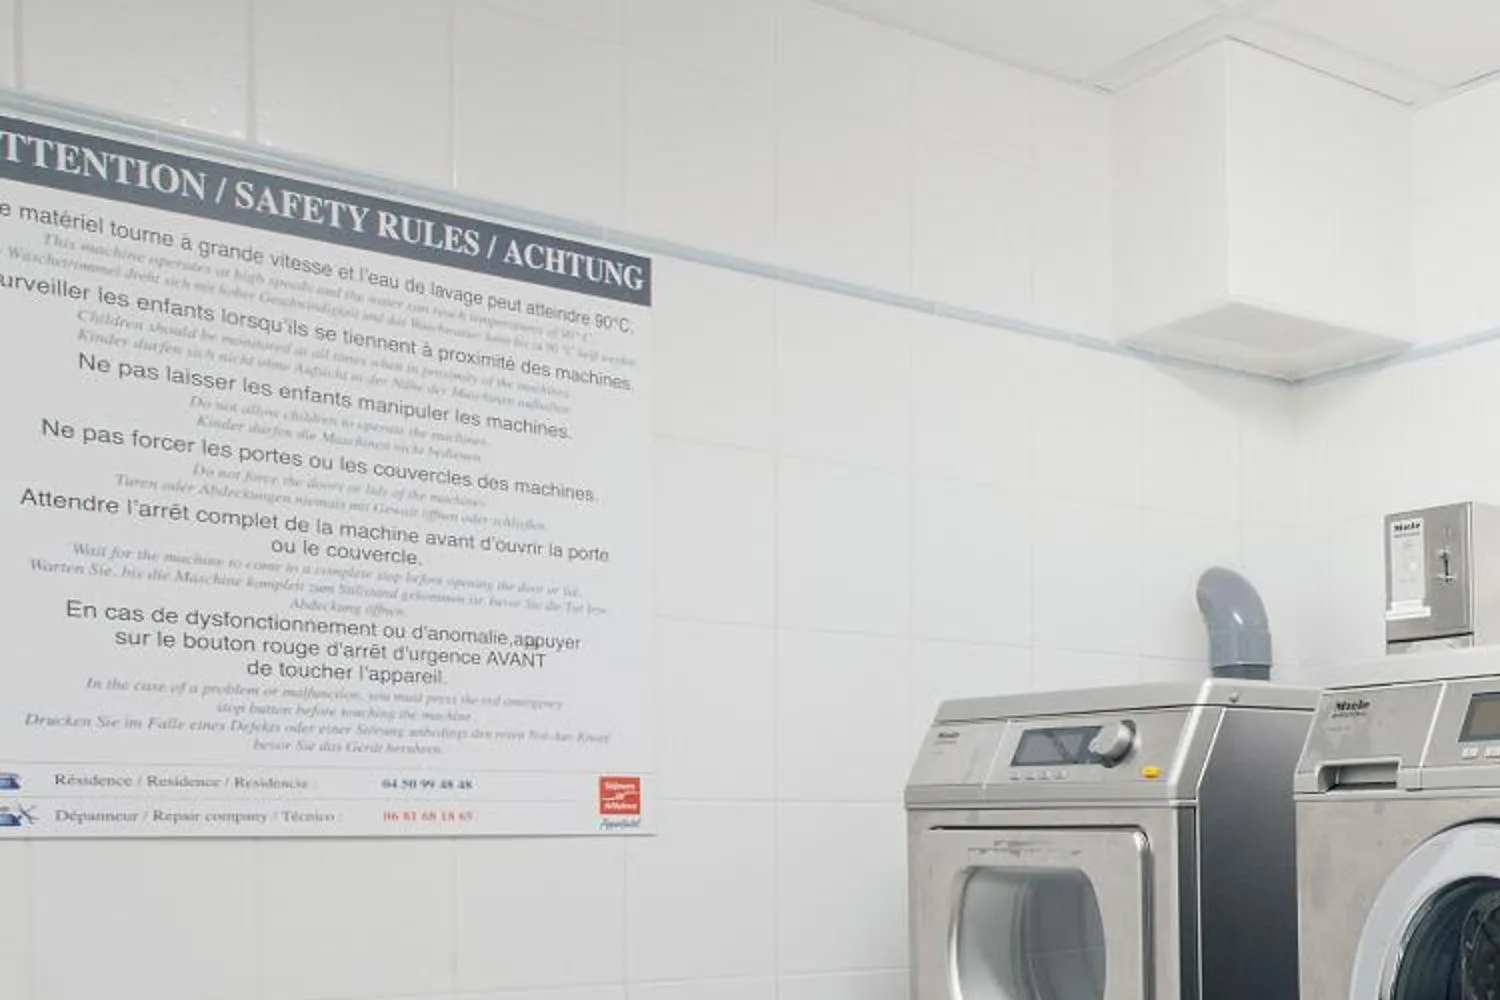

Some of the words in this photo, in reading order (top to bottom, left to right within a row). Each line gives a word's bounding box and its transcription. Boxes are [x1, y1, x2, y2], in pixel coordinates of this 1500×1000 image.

[0, 131, 206, 201] TTENTION
[234, 181, 369, 235] SAFETY
[377, 212, 479, 258] RULES
[503, 239, 646, 293] ACHTUNG
[0, 202, 11, 218] e
[19, 206, 103, 235] matériel
[110, 220, 173, 248] tourne
[198, 240, 264, 265] grande
[269, 251, 332, 278] vitesse
[337, 265, 353, 282] et
[359, 266, 399, 291] l'eau
[404, 275, 425, 295] de
[431, 280, 483, 309] lavage
[487, 295, 521, 314] peut
[525, 300, 591, 327] atteindre
[0, 273, 89, 301] urveiller
[98, 285, 129, 308] les
[137, 295, 215, 322] enfants
[315, 326, 336, 342] se
[343, 328, 417, 356] tiennent
[438, 346, 515, 372] proximité
[520, 357, 551, 378] des
[79, 353, 112, 375] Ne
[119, 363, 160, 382] pas
[167, 365, 238, 393] laisser
[244, 376, 273, 398] les
[279, 384, 351, 409] enfants
[358, 397, 450, 423] manipuler
[455, 407, 480, 427] les
[486, 415, 573, 440] machines.
[42, 418, 75, 440] Ne
[83, 427, 125, 447] pas
[132, 429, 197, 454] forcer
[203, 438, 233, 459] les
[239, 446, 303, 467] portes
[309, 455, 334, 471] ou
[339, 454, 367, 475] les
[373, 462, 471, 487] couvercles
[477, 471, 509, 492] des
[19, 487, 119, 515] Attendre
[127, 497, 189, 521] l'arrêt
[195, 508, 279, 531] complet
[285, 513, 310, 533] de
[315, 516, 332, 535] la
[338, 522, 419, 544] machine
[425, 531, 474, 549] avant
[480, 533, 542, 556] d'ouvrir
[548, 540, 563, 558] la
[567, 545, 609, 563] porte
[109, 545, 134, 561] for
[137, 548, 160, 563] the
[271, 540, 295, 556] ou
[302, 539, 319, 558] le
[325, 545, 422, 566] couvercle.
[66, 600, 97, 620] En
[105, 607, 145, 623] cas
[151, 605, 179, 625] de
[185, 608, 375, 637] dysfonctionnement
[383, 625, 405, 639] ou
[114, 632, 151, 648] sur
[156, 630, 175, 649] le
[182, 632, 255, 653] bouton
[262, 640, 320, 660] rouge
[326, 639, 386, 660] d'arrêt
[392, 643, 481, 667] d'urgence
[486, 648, 546, 668] AVANT
[106, 676, 129, 691] the
[246, 658, 272, 677] de
[279, 661, 352, 680] toucher
[152, 808, 201, 825] Repair
[204, 811, 267, 825] company
